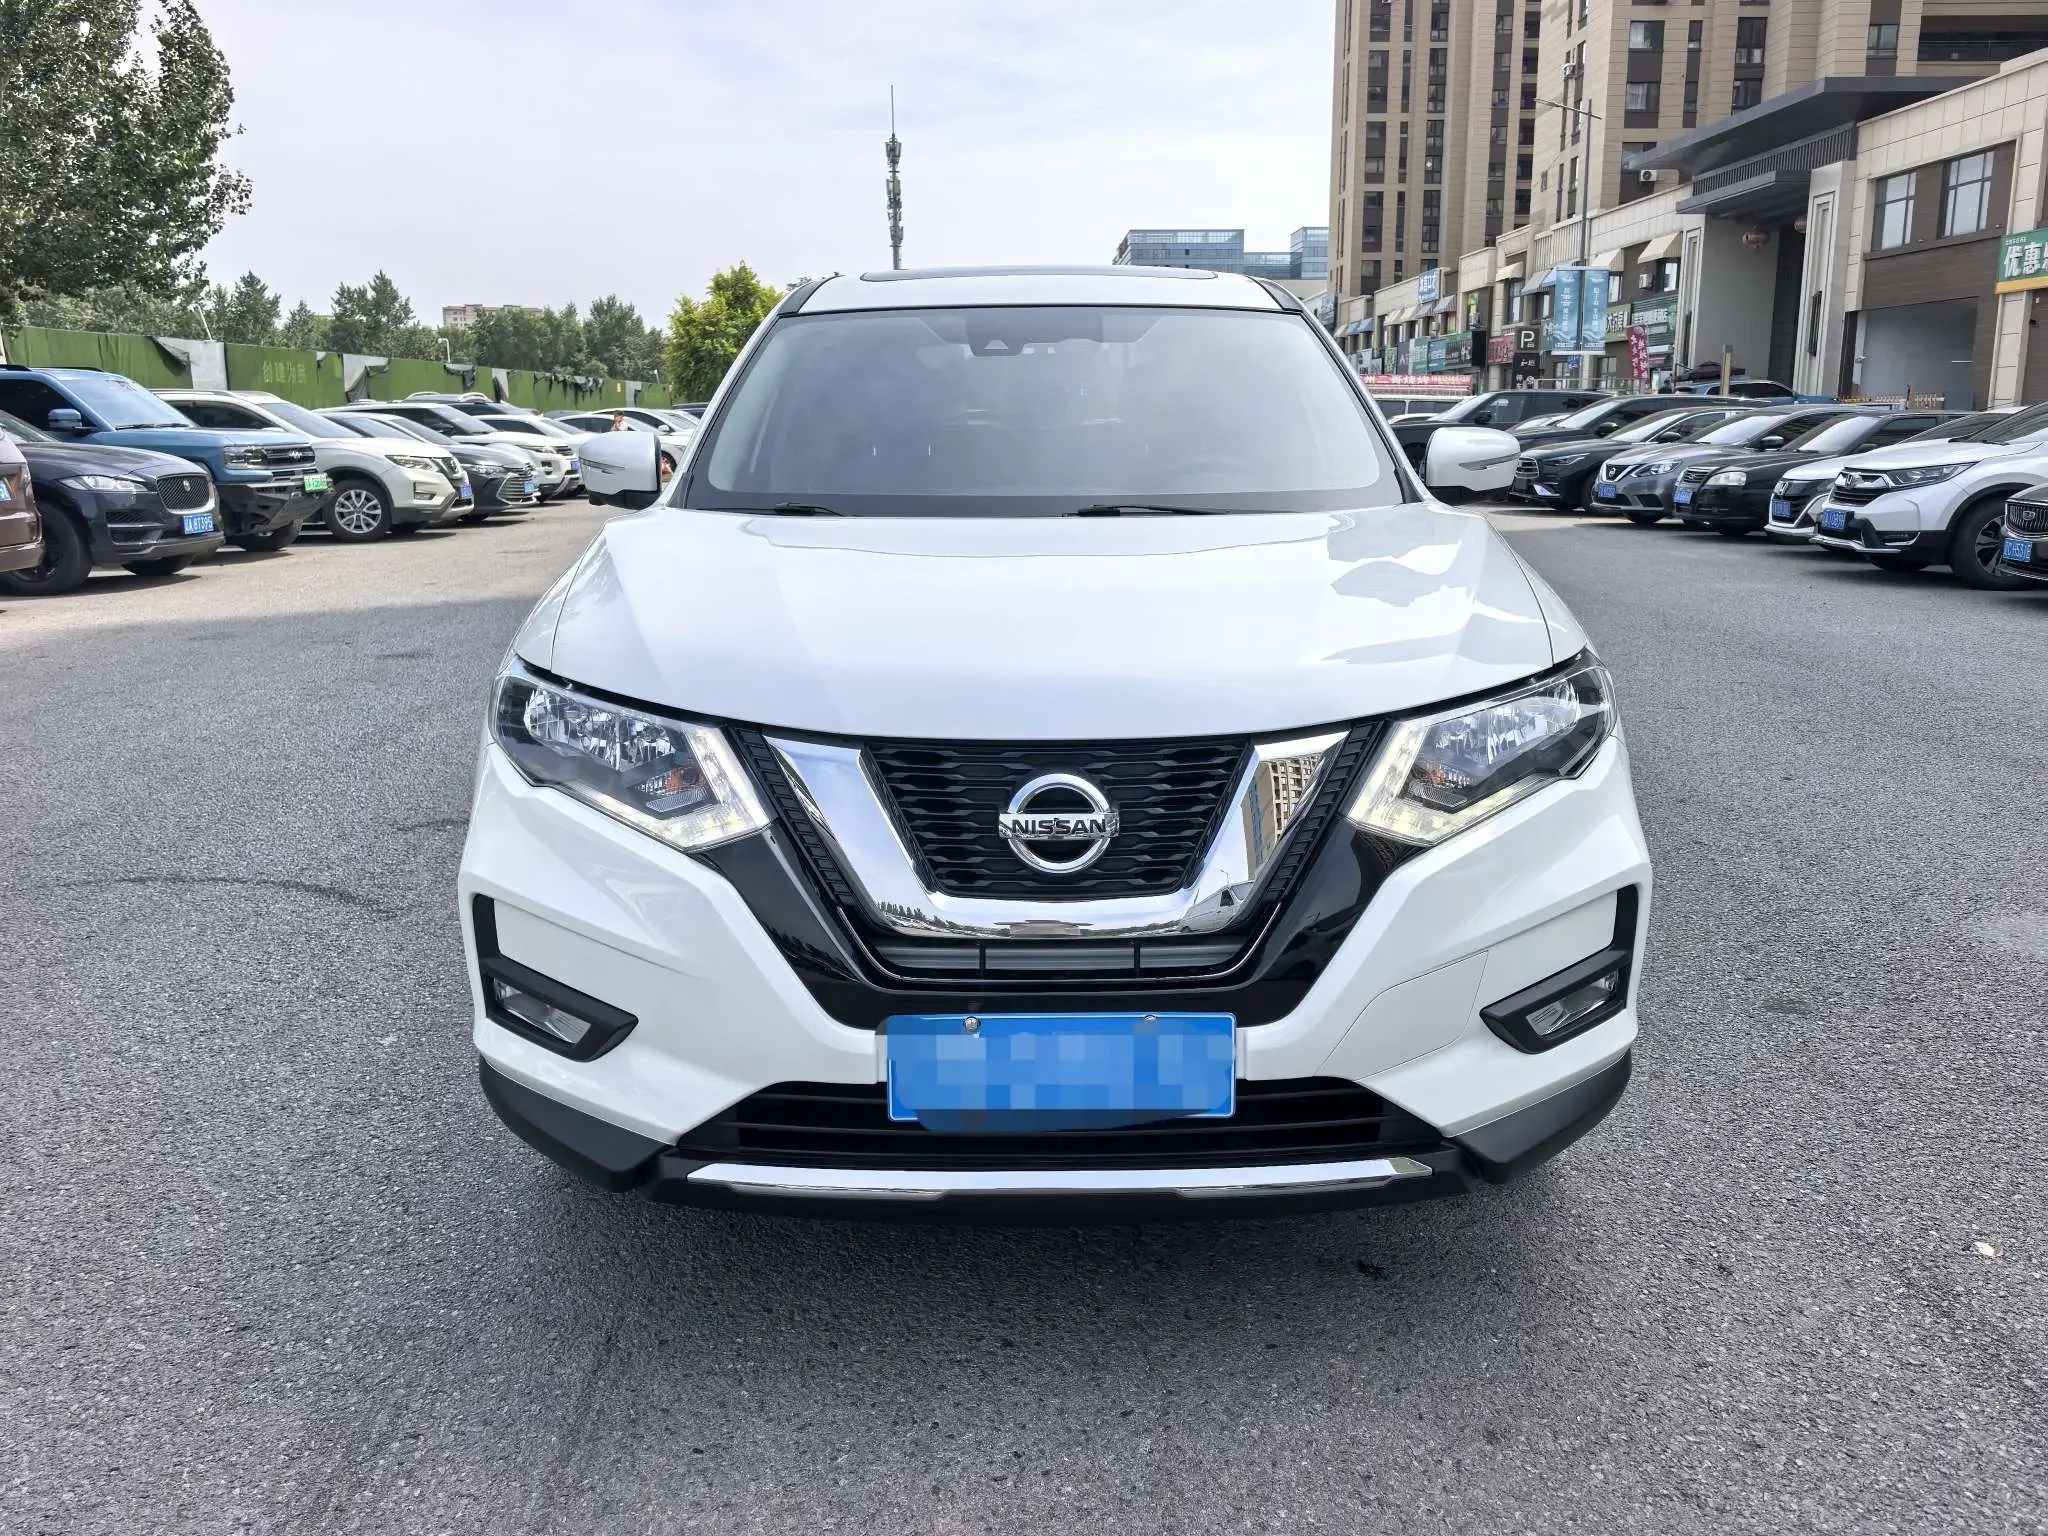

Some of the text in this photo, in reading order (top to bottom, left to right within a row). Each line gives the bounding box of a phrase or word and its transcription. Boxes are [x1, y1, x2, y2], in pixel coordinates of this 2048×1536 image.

[2003, 241, 2048, 279] 优惠
[1520, 330, 1535, 349] P
[1011, 818, 1107, 834] NISSAN
